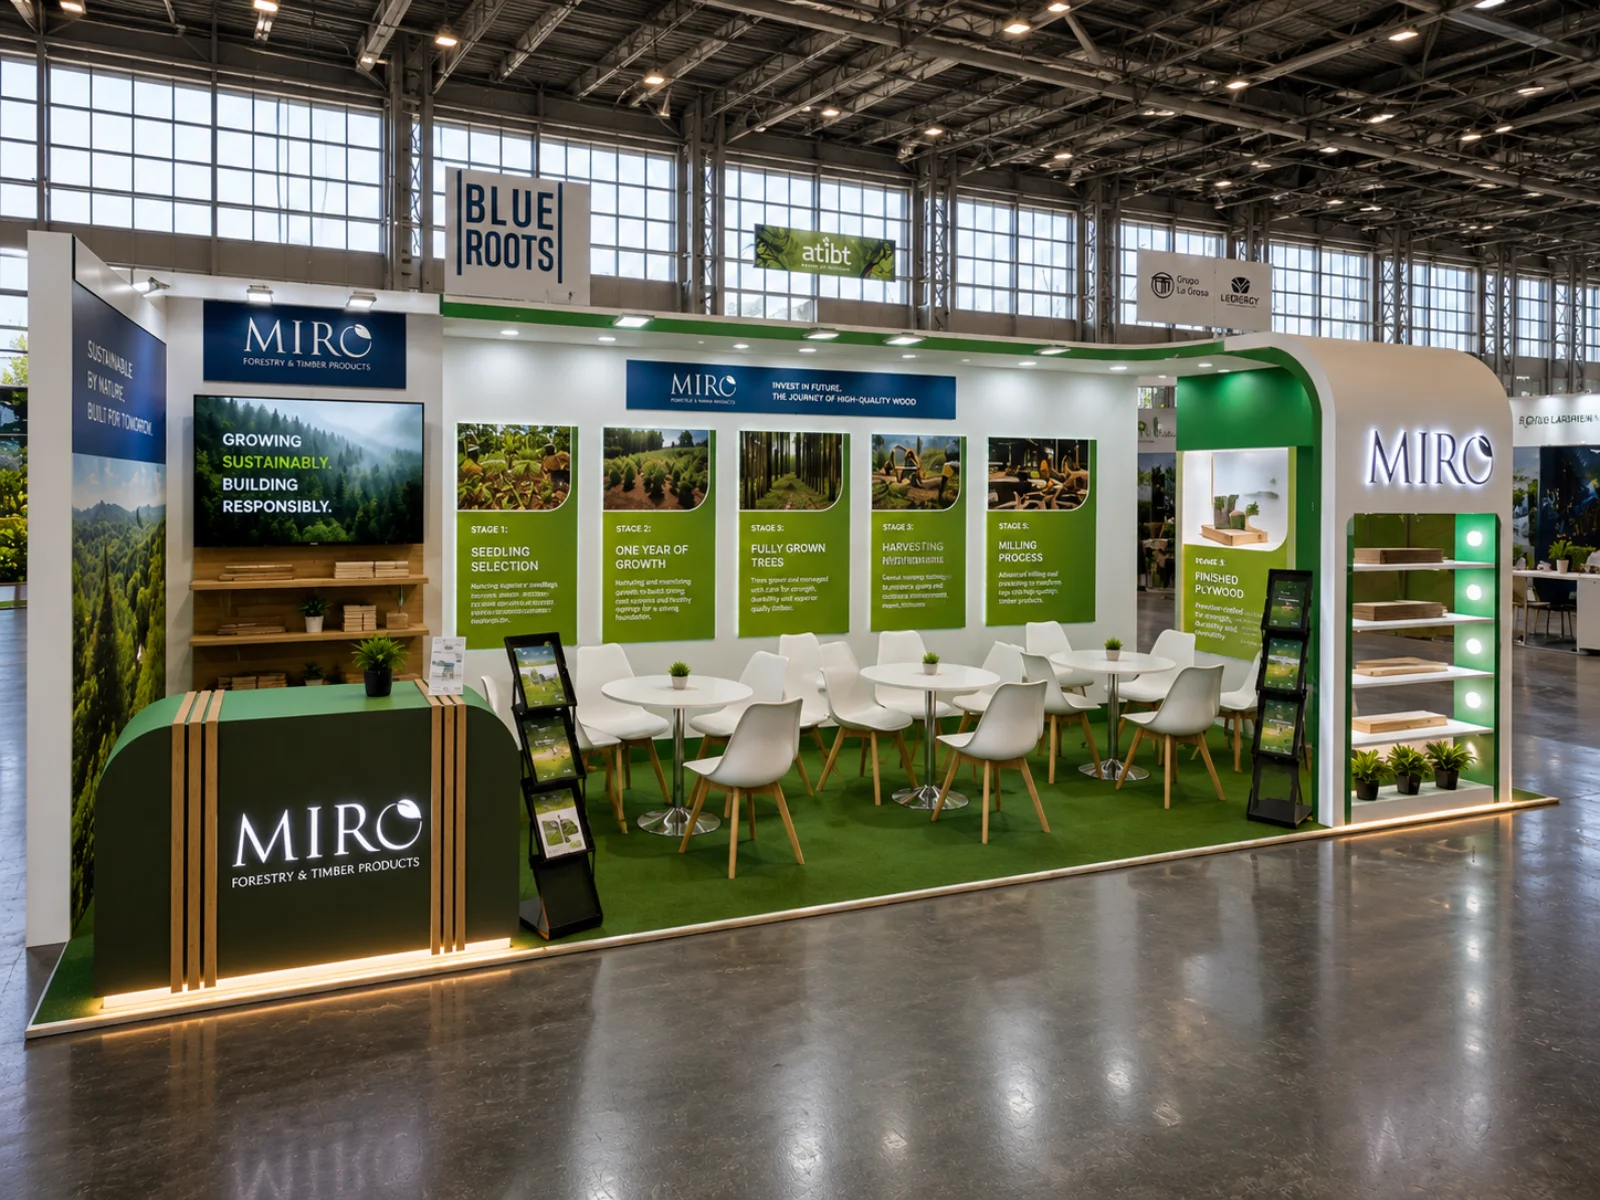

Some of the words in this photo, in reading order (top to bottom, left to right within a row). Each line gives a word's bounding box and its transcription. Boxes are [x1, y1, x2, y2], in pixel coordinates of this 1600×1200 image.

[466, 183, 554, 231] BLUE
[466, 229, 554, 272] ROOTS
[802, 240, 851, 265] atibt
[243, 316, 372, 358] MIRO
[87, 340, 133, 380] SUSTAINABLE
[243, 357, 285, 367] FORESTRY
[287, 359, 295, 367] &
[297, 360, 327, 369] TIMBER
[328, 361, 371, 371] PRODUCTS
[87, 371, 98, 391] BY
[671, 372, 736, 397] MIRO
[772, 381, 799, 390] INVEST
[788, 393, 823, 402] JOURNEY
[893, 398, 917, 406] WOOD
[87, 402, 106, 423] BUILT
[222, 432, 302, 448] GROWING
[222, 455, 332, 470] SUSTAINABLY.
[1366, 430, 1495, 485] MIRO
[222, 478, 298, 491] BUILDING
[222, 500, 332, 513] RESPONSIBLY.
[471, 525, 498, 534] STAGE
[882, 523, 905, 531] STAGE
[471, 547, 530, 557] SEEDLING
[615, 545, 639, 555] ONE
[642, 545, 671, 555] YEAR
[673, 544, 688, 554] OF
[751, 544, 783, 553] FULLY
[786, 543, 826, 553] GROWN
[882, 542, 944, 552] HARVESTING
[999, 540, 1037, 550] MILLING
[615, 559, 666, 569] GROWTH
[751, 558, 784, 567] TREES
[999, 553, 1043, 562] PROCESS
[471, 561, 539, 572] SELECTION
[1195, 571, 1238, 585] FINISHED
[1195, 584, 1244, 599] PLYWOOD
[232, 799, 422, 867] MIRO
[232, 871, 294, 888] FORESTRY
[297, 870, 307, 880] &
[311, 863, 355, 879] TIMBER
[358, 857, 420, 873] PRODUCTS
